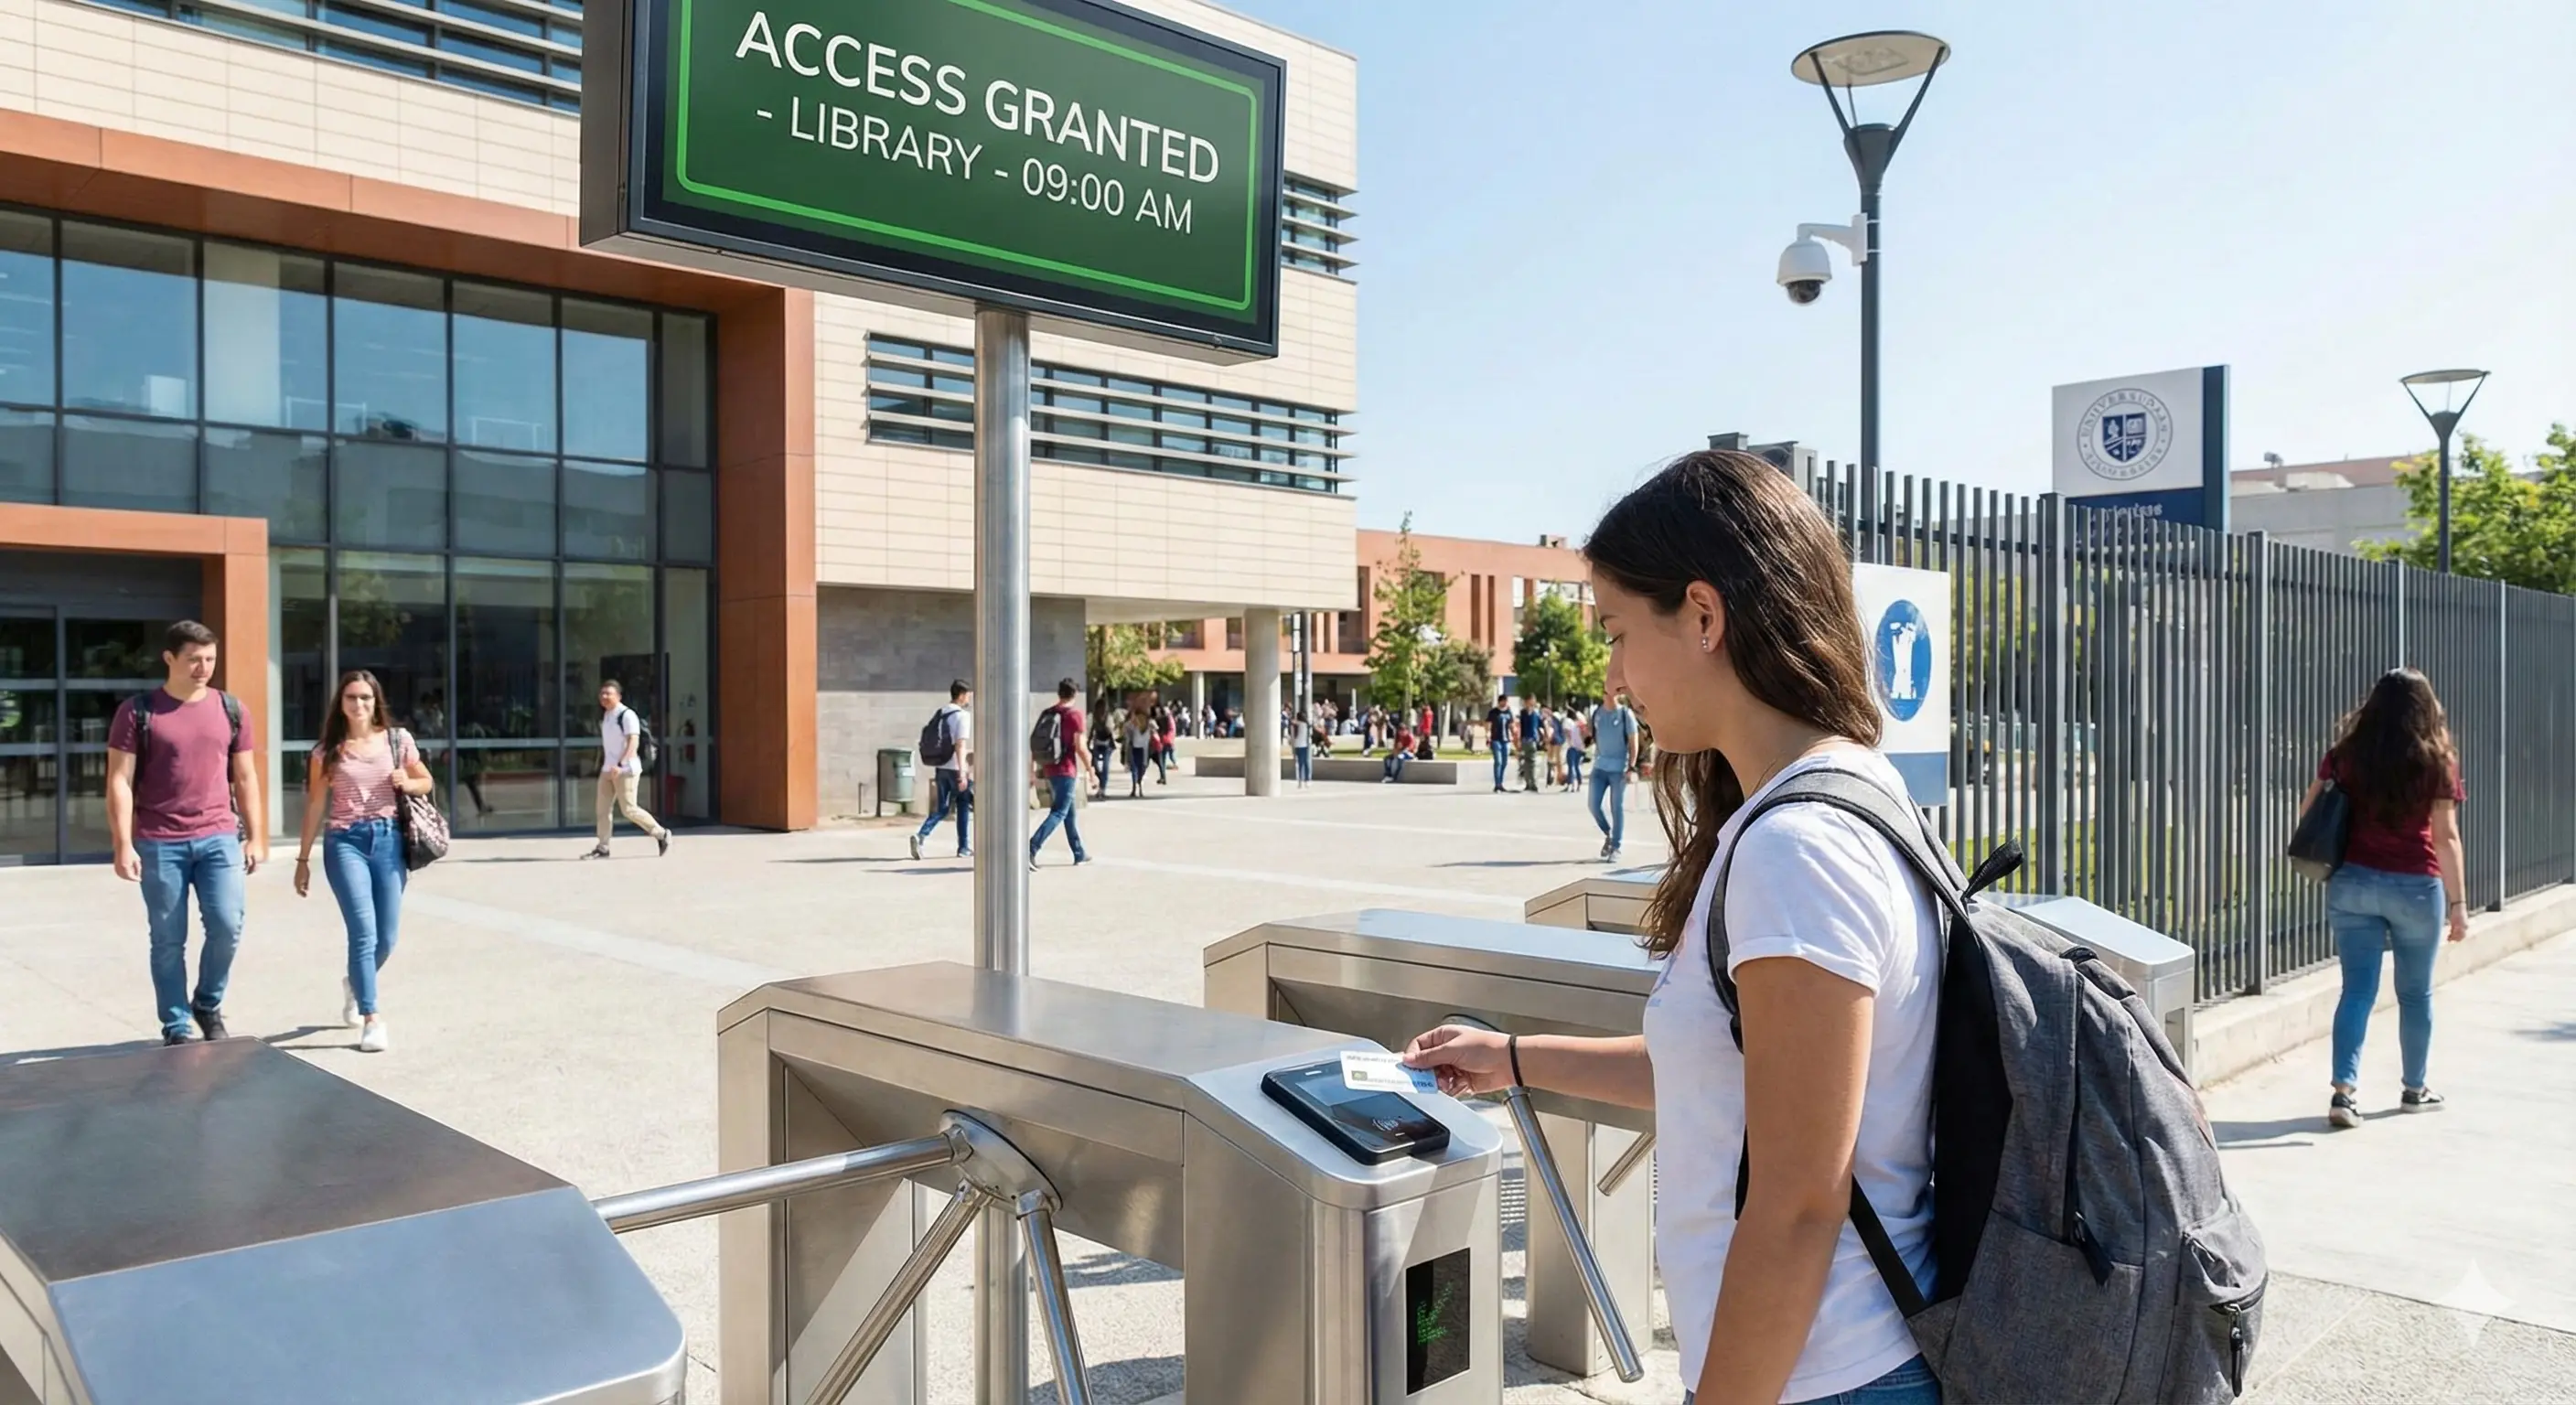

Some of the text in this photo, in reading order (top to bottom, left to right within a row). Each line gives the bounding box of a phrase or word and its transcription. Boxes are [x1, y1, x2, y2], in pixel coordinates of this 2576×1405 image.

[735, 11, 1219, 184] ACCESS GRANTED
[757, 96, 1193, 234] - LIBRARY - 09:00 AM
